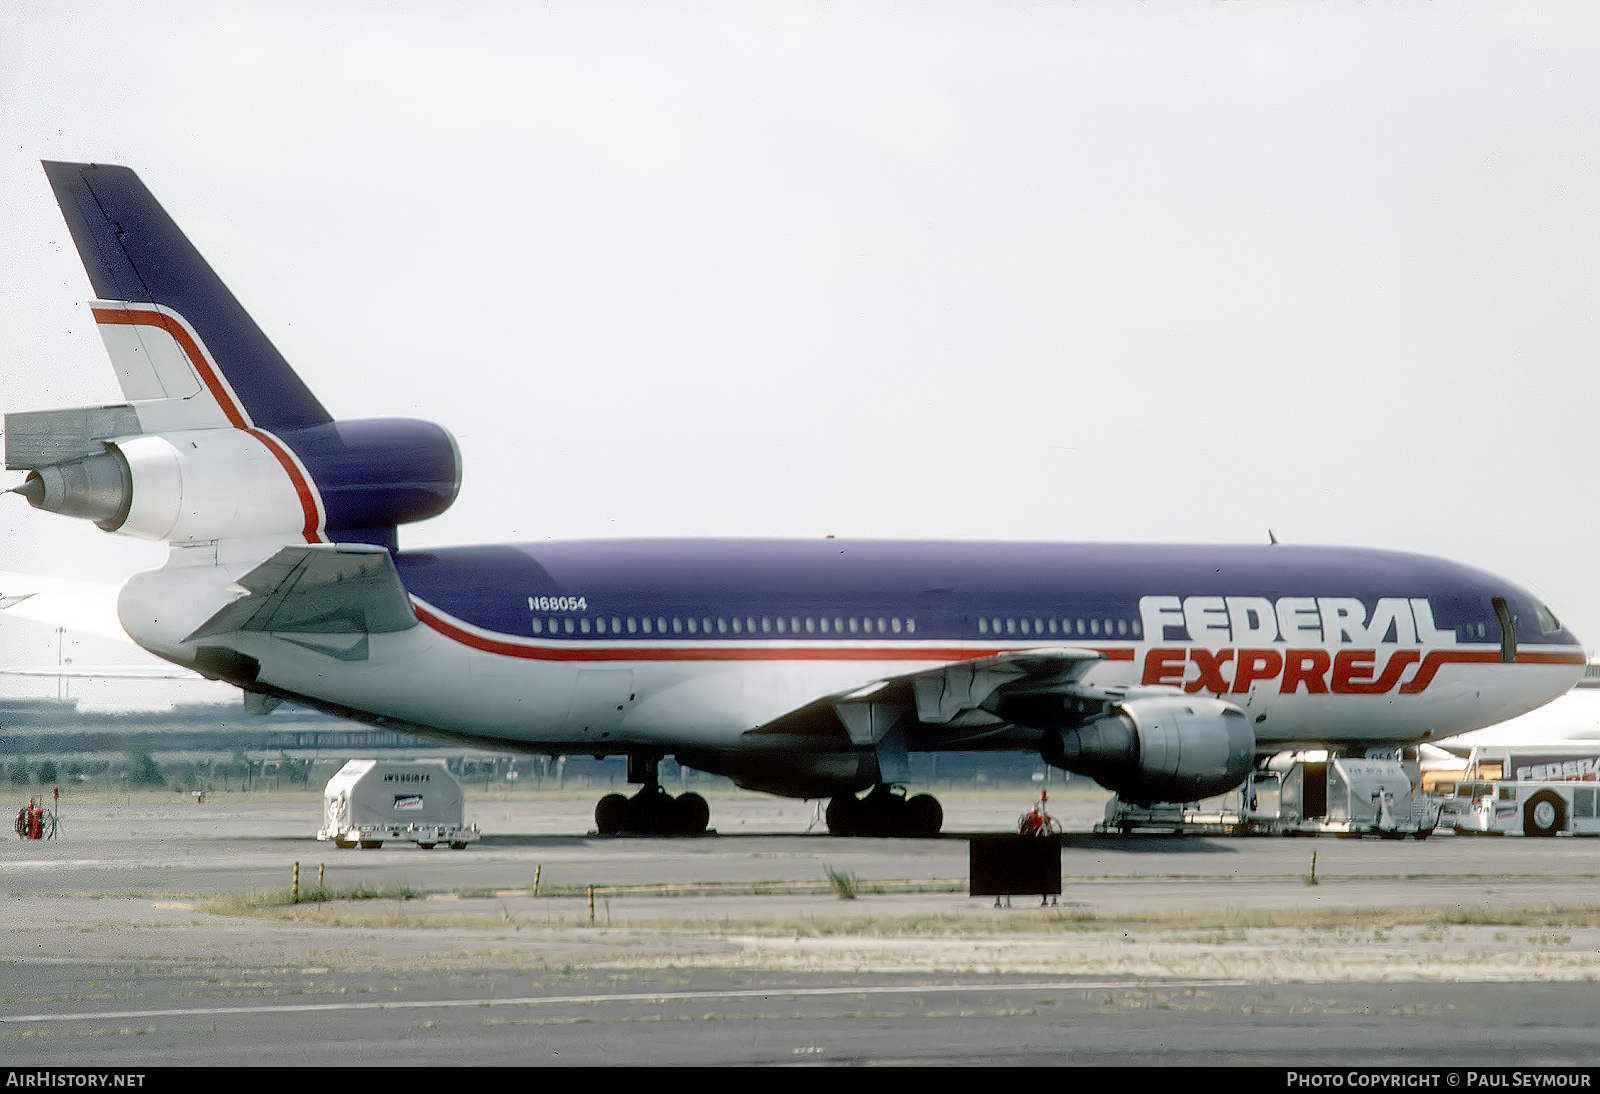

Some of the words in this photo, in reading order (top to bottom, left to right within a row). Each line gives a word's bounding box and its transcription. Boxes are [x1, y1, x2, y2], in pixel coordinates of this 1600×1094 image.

[527, 596, 588, 611] N68054
[1139, 595, 1456, 643] FEDERAL
[1142, 647, 1444, 694] EXPRESS
